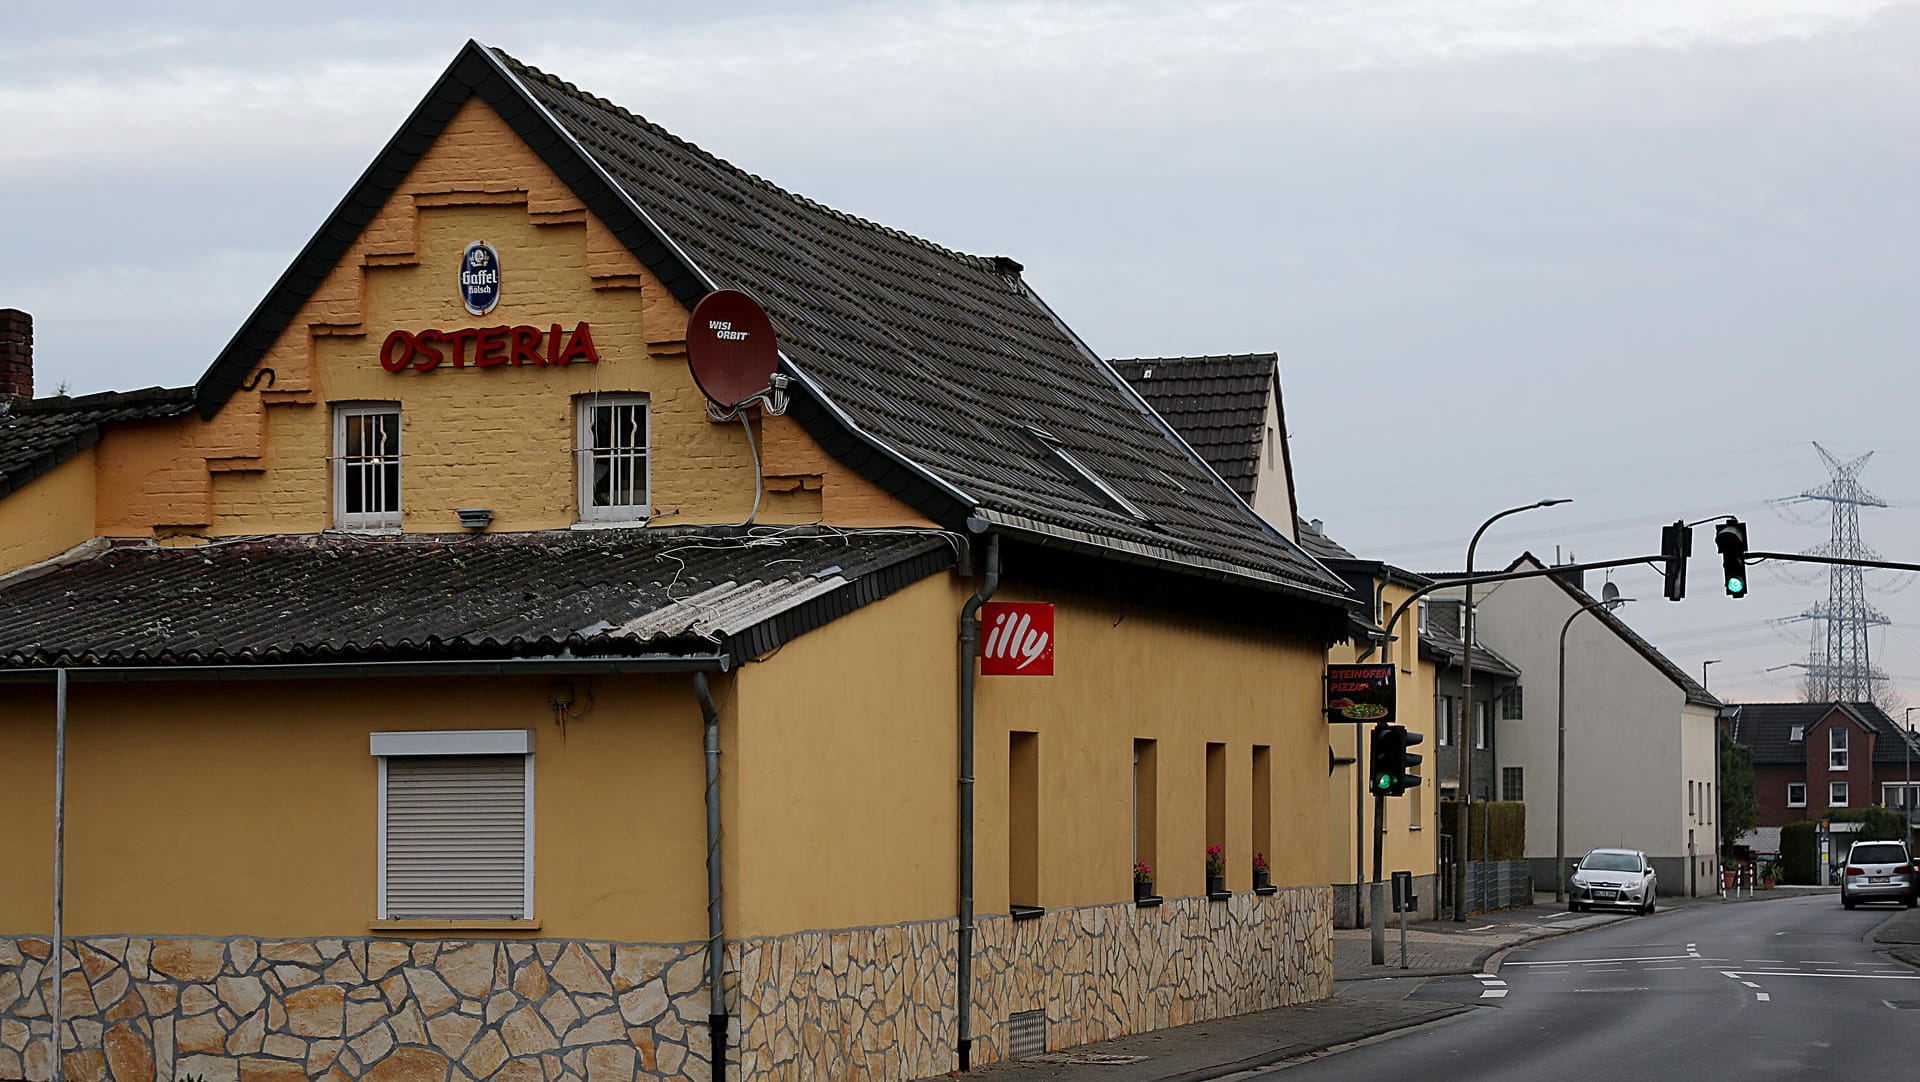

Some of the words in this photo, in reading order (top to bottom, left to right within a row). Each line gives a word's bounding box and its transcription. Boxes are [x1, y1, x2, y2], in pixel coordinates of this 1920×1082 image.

[462, 270, 498, 285] Gaffel
[709, 320, 732, 330] WISI
[716, 330, 748, 341] ORBIT
[380, 321, 599, 372] OSTERIA
[985, 611, 1049, 670] illy
[1331, 669, 1390, 679] STEINOFEN
